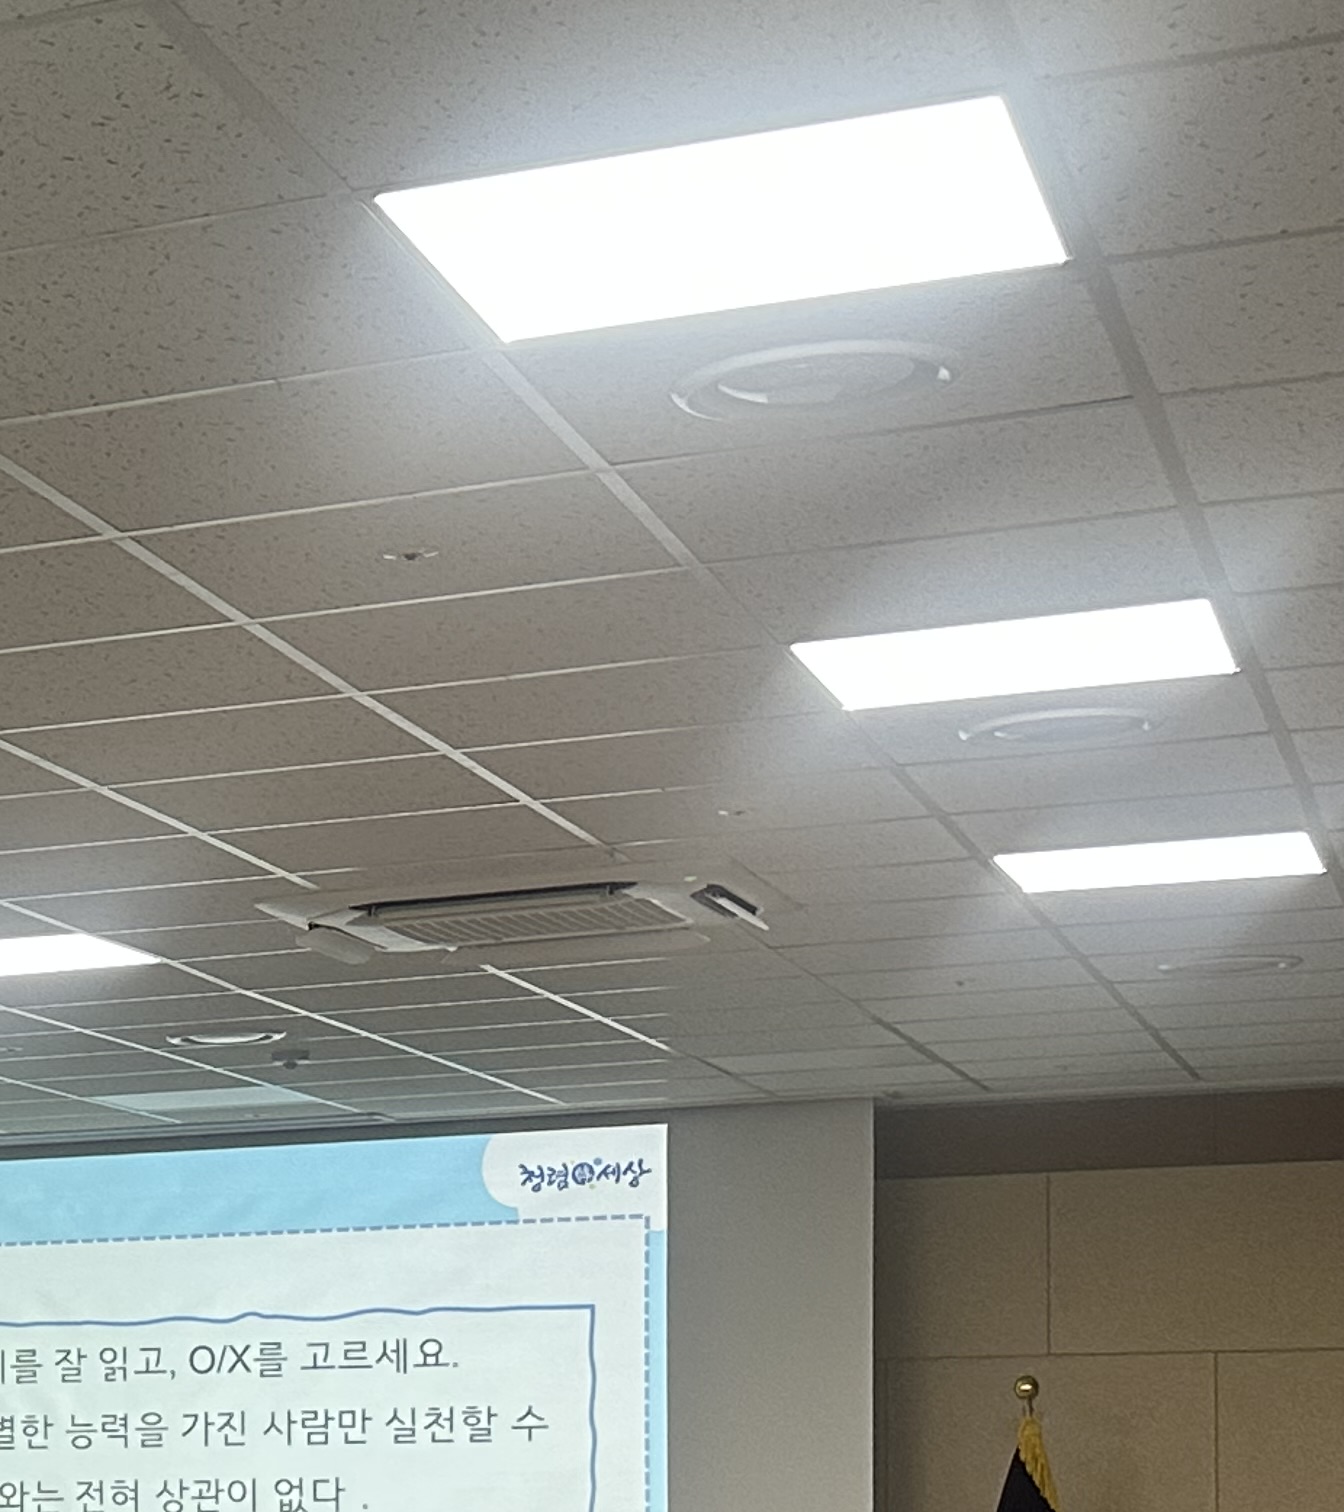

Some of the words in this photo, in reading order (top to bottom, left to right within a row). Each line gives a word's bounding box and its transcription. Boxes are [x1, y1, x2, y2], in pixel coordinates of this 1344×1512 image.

[53, 1346, 90, 1385] 잘
[97, 1344, 178, 1384] 읽고,
[187, 1340, 290, 1380] O/X를
[298, 1336, 461, 1376] 고르세요.
[63, 1410, 171, 1452] 능력을
[179, 1408, 248, 1449] 가진
[261, 1406, 375, 1448] 사람만
[383, 1403, 500, 1446] 실천할
[509, 1403, 551, 1444] 수
